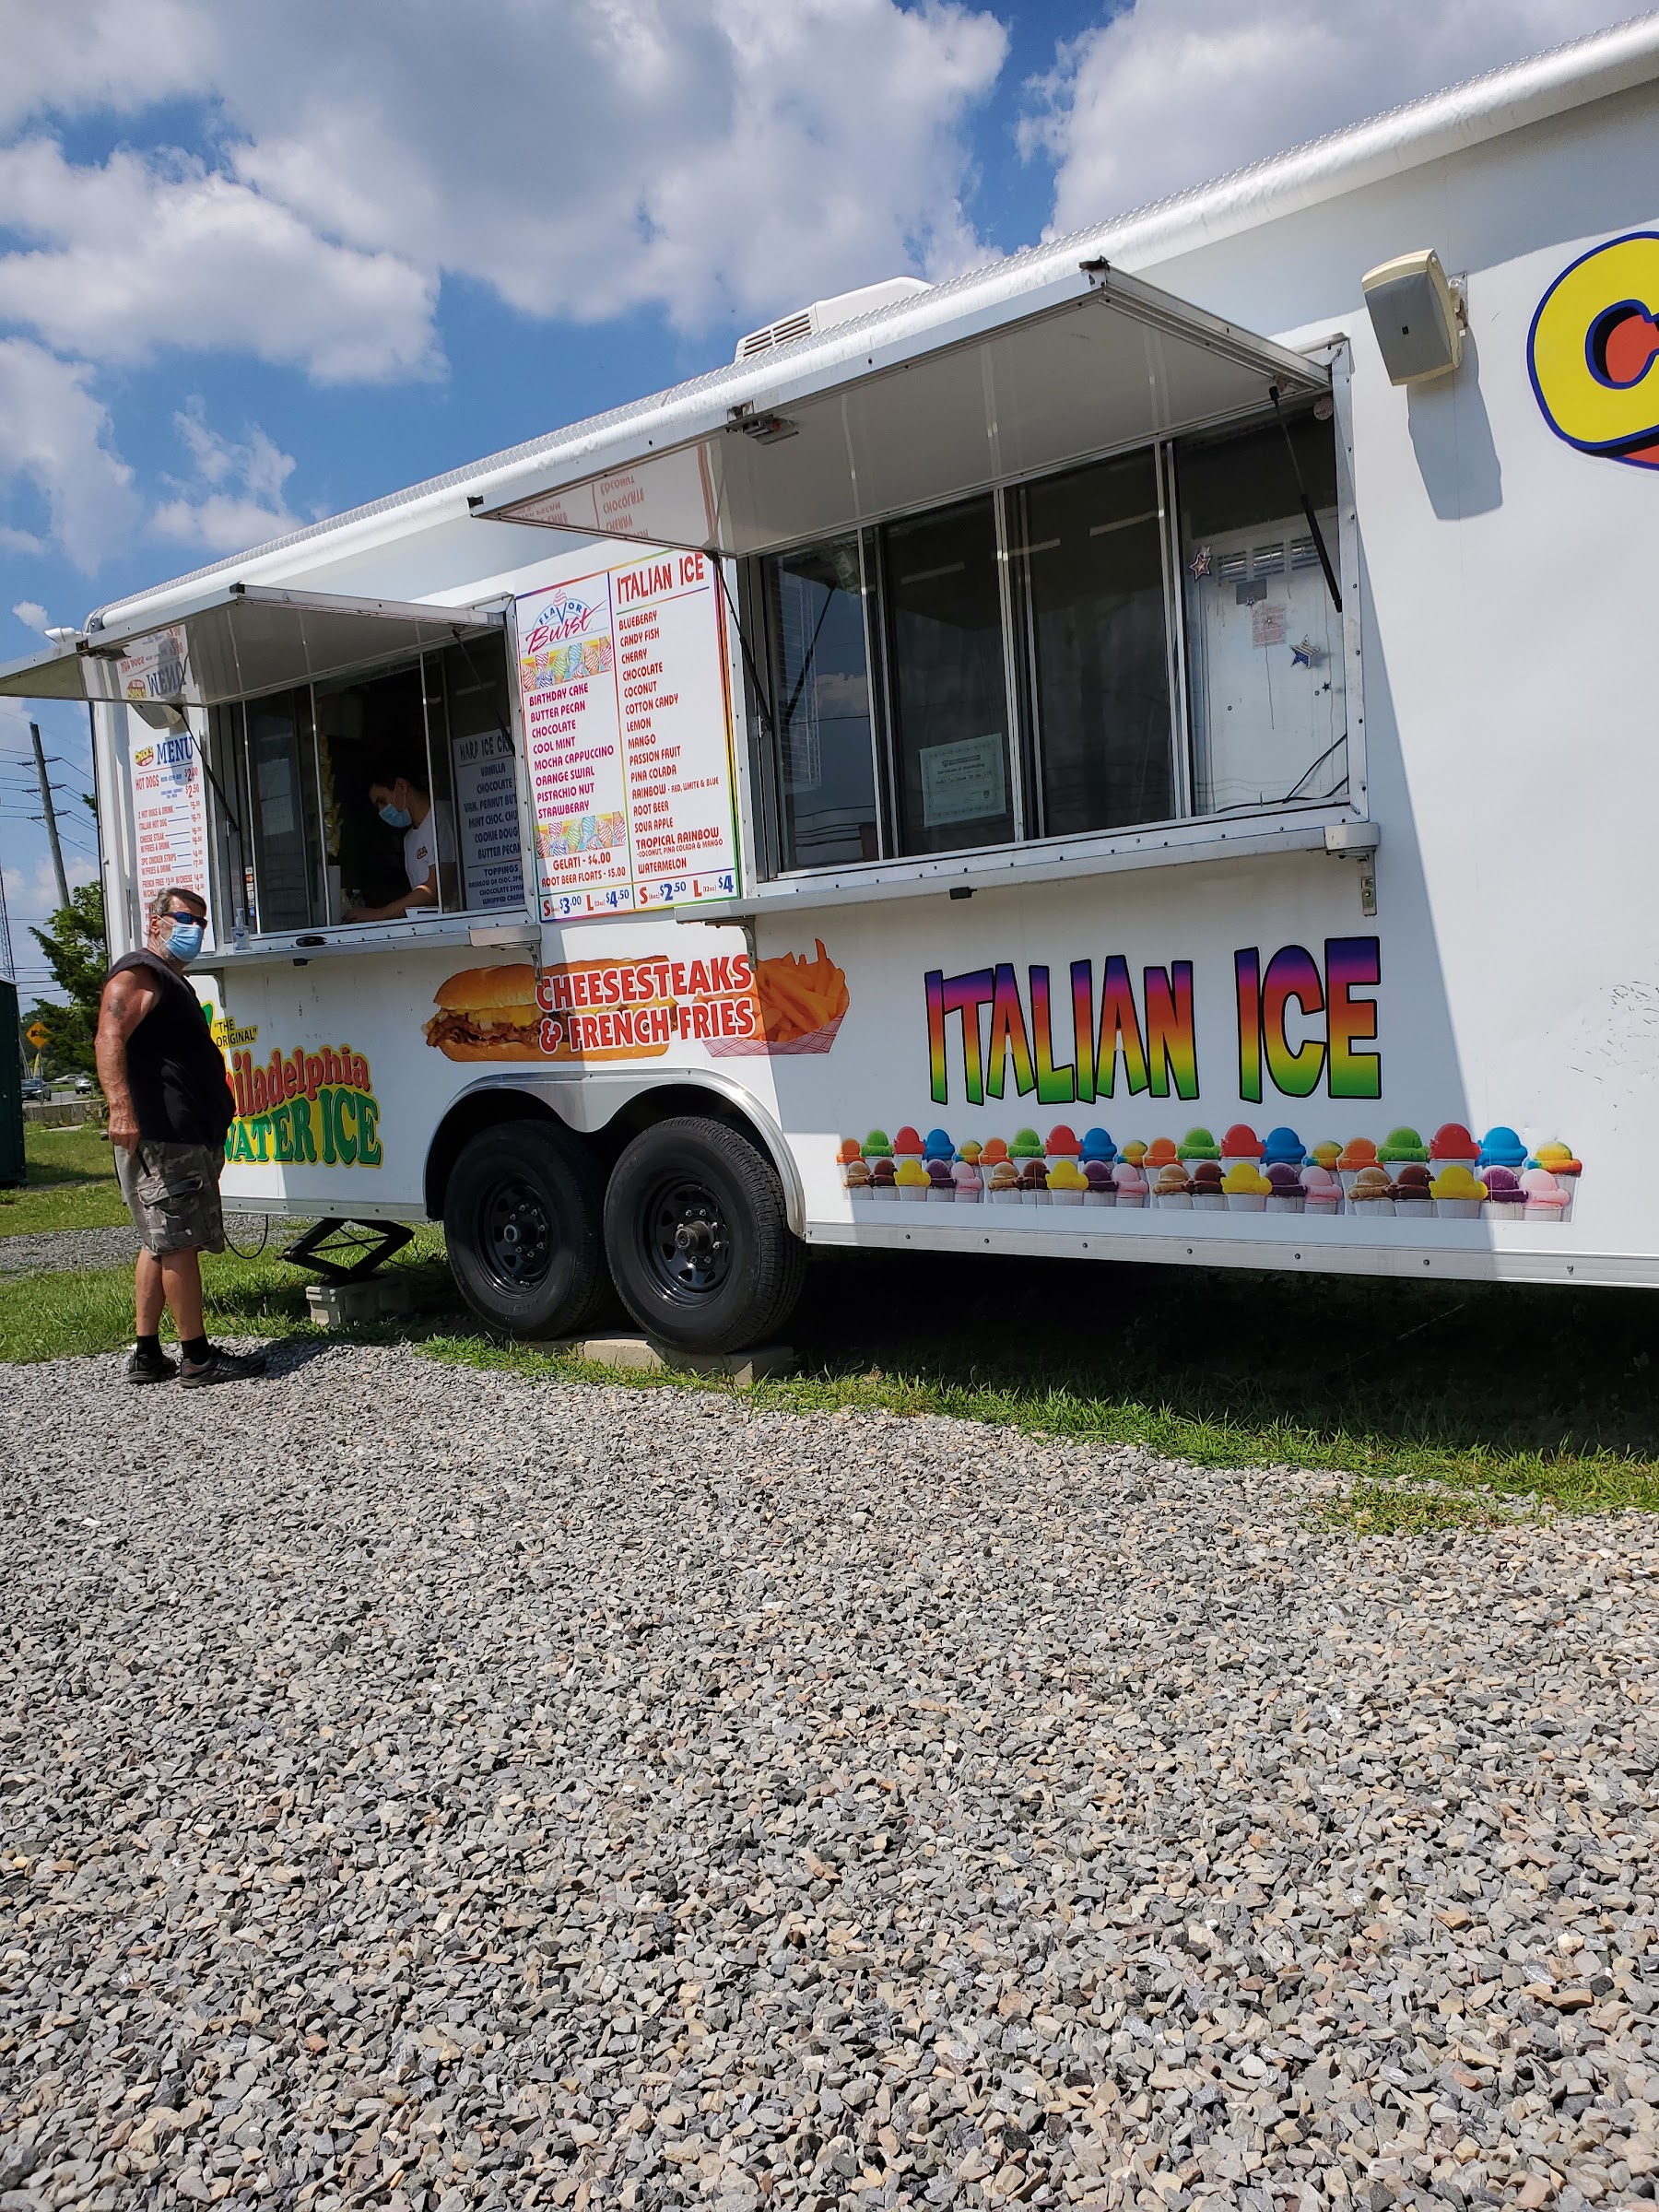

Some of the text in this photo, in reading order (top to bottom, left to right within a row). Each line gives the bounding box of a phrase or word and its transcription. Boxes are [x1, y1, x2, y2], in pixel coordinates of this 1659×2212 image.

[617, 553, 704, 605] ITALIAN ICE
[538, 601, 582, 626] FLAVOR
[618, 610, 657, 631] BLUEBERRY
[525, 599, 607, 655] Burst
[619, 628, 660, 648] CANDY FISH
[621, 648, 648, 665] CHERRY
[622, 662, 664, 682] CHOCOLATE
[529, 683, 589, 707] BIRTHDAY CAKE
[624, 680, 657, 699] COCONUT
[530, 700, 586, 724] BUTTER PECAN
[625, 693, 679, 715] COTTON CANDY
[531, 719, 577, 739] CHOCOLATE
[627, 717, 652, 733] LEMON
[157, 736, 194, 765] MENU
[481, 736, 495, 757] ICE
[533, 735, 576, 755] COOL MINT
[628, 734, 656, 750] MANGO
[534, 745, 615, 771] MOCHA CAPPUCCINO
[629, 745, 681, 767] PASSION FRUIT
[479, 762, 506, 777] VANILLA
[535, 766, 595, 787] ORANGE SWIRL
[630, 764, 677, 783] PINA COLADA
[135, 777, 146, 792] HOT
[146, 774, 159, 789] DOGS
[476, 777, 512, 794] CHOCOLATE
[536, 782, 595, 803] PISTACHIO NUT
[631, 783, 666, 800] RAINBOW
[683, 780, 700, 791] WHITE
[706, 776, 719, 787] BLUE
[479, 795, 504, 811] PEANUT
[538, 800, 590, 819] STRAWBERRY
[633, 800, 669, 817] ROOT BEER
[468, 816, 485, 829] MINT
[634, 817, 674, 833] SOUR APPLE
[474, 830, 498, 844] COOKIE
[636, 827, 719, 851] TROPICAL RAINBOW
[664, 846, 676, 855] PINA
[676, 842, 696, 853] COLADA
[702, 838, 724, 849] MANGO
[477, 845, 501, 860] BUTTER
[553, 856, 581, 871] GELATI
[588, 852, 611, 866] $4.00
[484, 864, 519, 877] TOPPINGS
[638, 857, 688, 875] WATERMELON
[541, 876, 560, 888] ROOT
[561, 873, 578, 885] BEER
[578, 869, 603, 883] FLOATS
[607, 865, 626, 878] $5.00
[693, 879, 702, 898] L
[718, 875, 734, 893] $4
[479, 885, 510, 897] CHOCOLATE
[482, 895, 507, 905] WHIPPED
[585, 894, 594, 912] L
[606, 888, 629, 908] $4.50
[640, 886, 648, 904] S
[543, 900, 551, 917] S
[559, 895, 582, 914] $3.00
[536, 953, 753, 1011] CHEESESTEAKS
[539, 998, 755, 1053] & FRENCH FRIES
[924, 935, 1382, 1106] ITALIAN ICE
[226, 1047, 371, 1117] iladelphia
[319, 1088, 382, 1165] ICE
